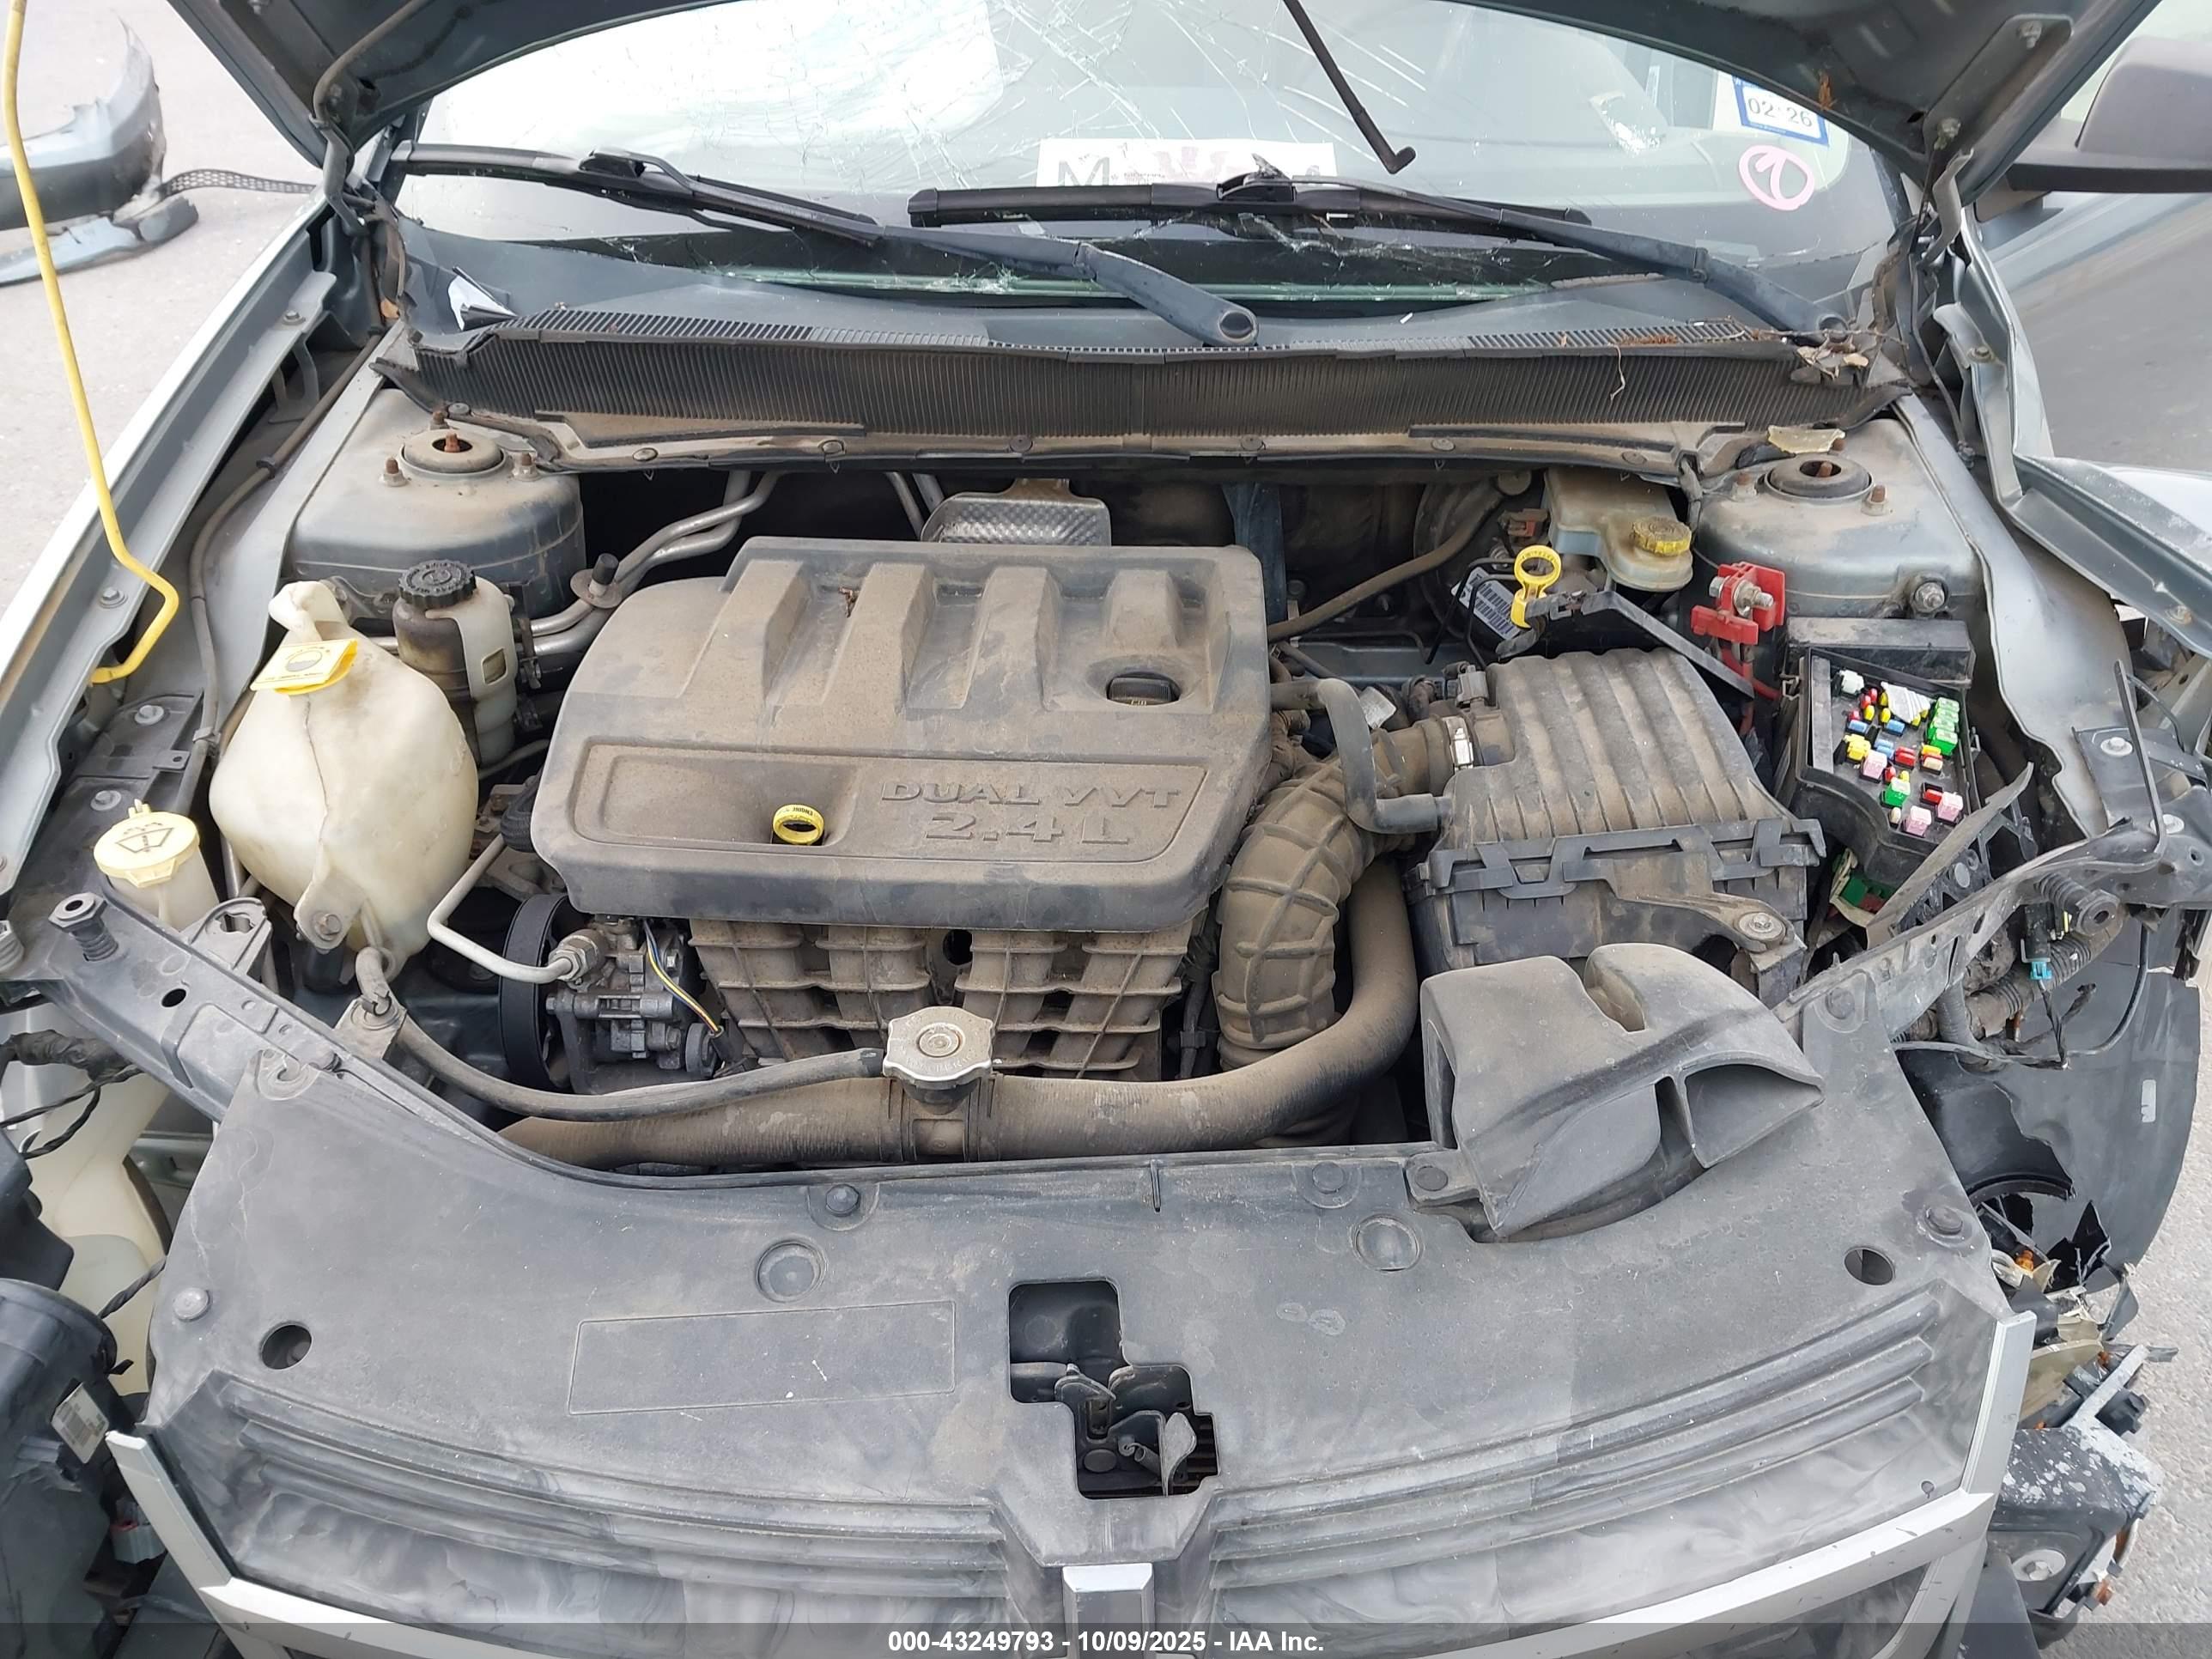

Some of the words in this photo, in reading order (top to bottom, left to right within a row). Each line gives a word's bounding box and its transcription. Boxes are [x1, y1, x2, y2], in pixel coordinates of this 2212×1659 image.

[882, 781, 1040, 805] DUAL
[1062, 785, 1181, 808] VVT
[926, 812, 1130, 845] 2.4L
